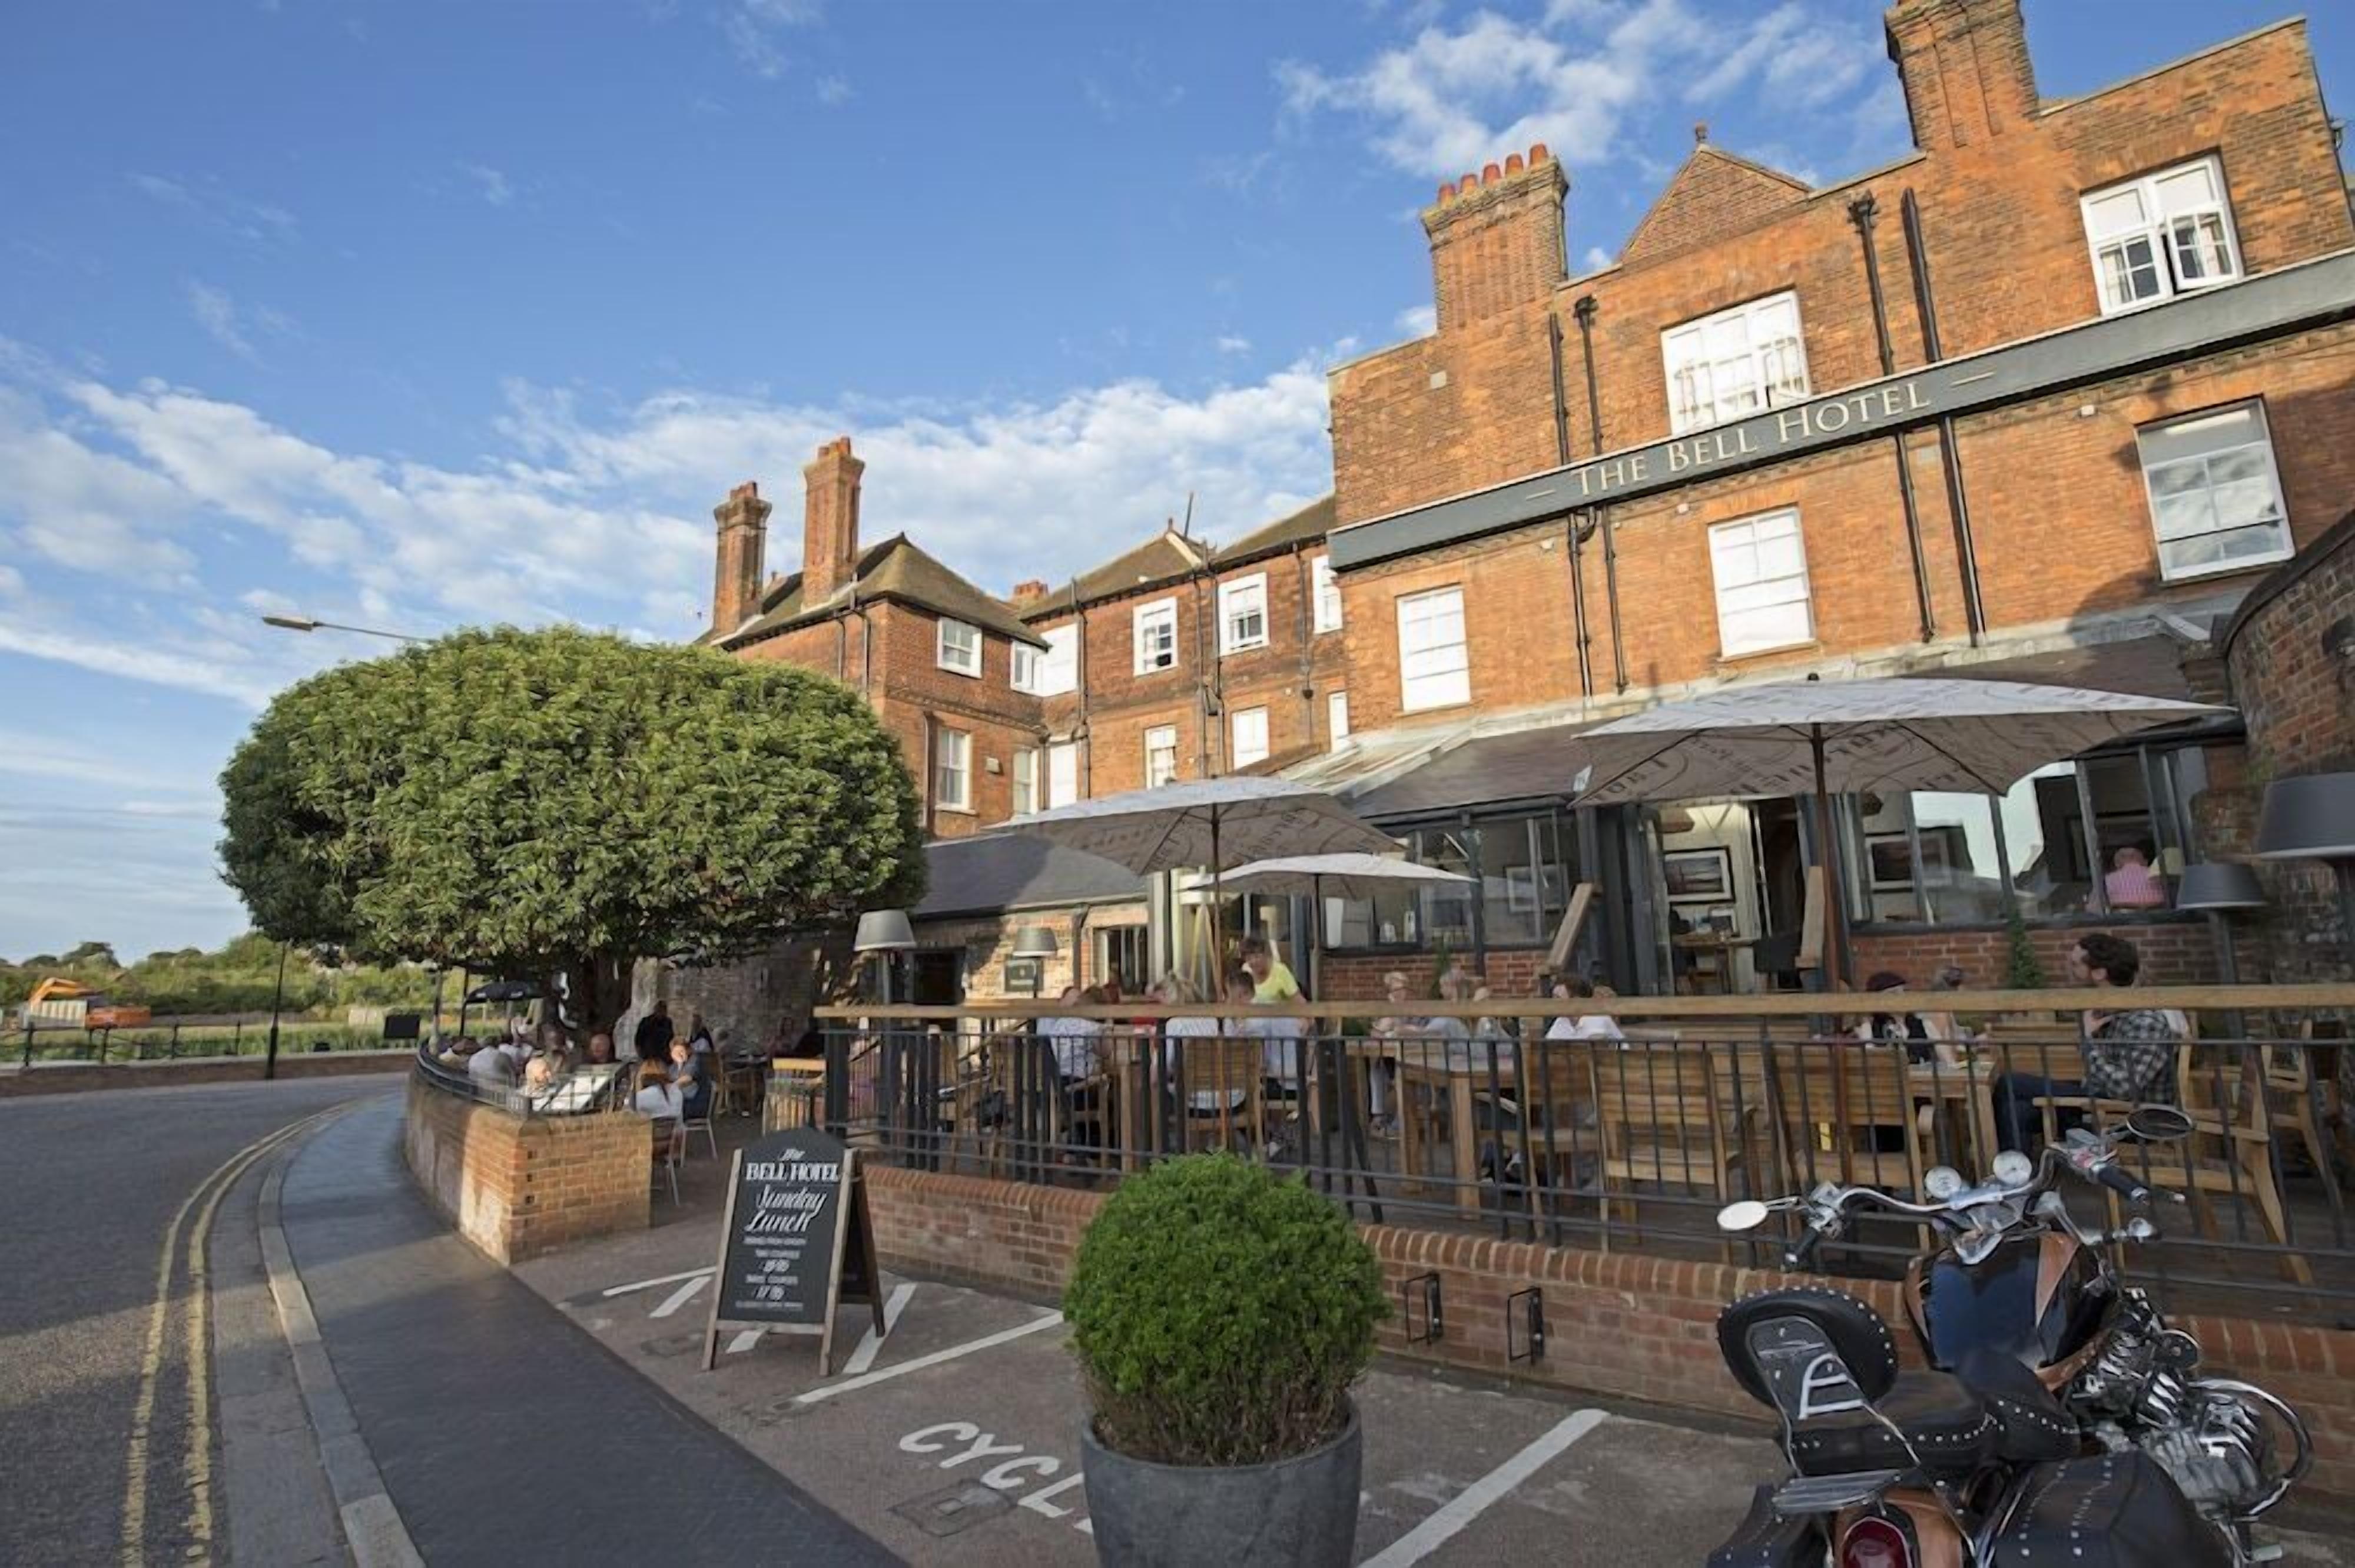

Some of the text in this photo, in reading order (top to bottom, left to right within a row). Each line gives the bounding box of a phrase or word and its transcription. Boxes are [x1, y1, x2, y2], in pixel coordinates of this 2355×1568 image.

[1573, 382, 1931, 496] THE BELL HOTEL
[745, 1162, 839, 1182] BELL HOTEL
[757, 1184, 827, 1214] Sunday
[744, 1210, 813, 1233] Lunch
[899, 1421, 1093, 1534] CYCL
